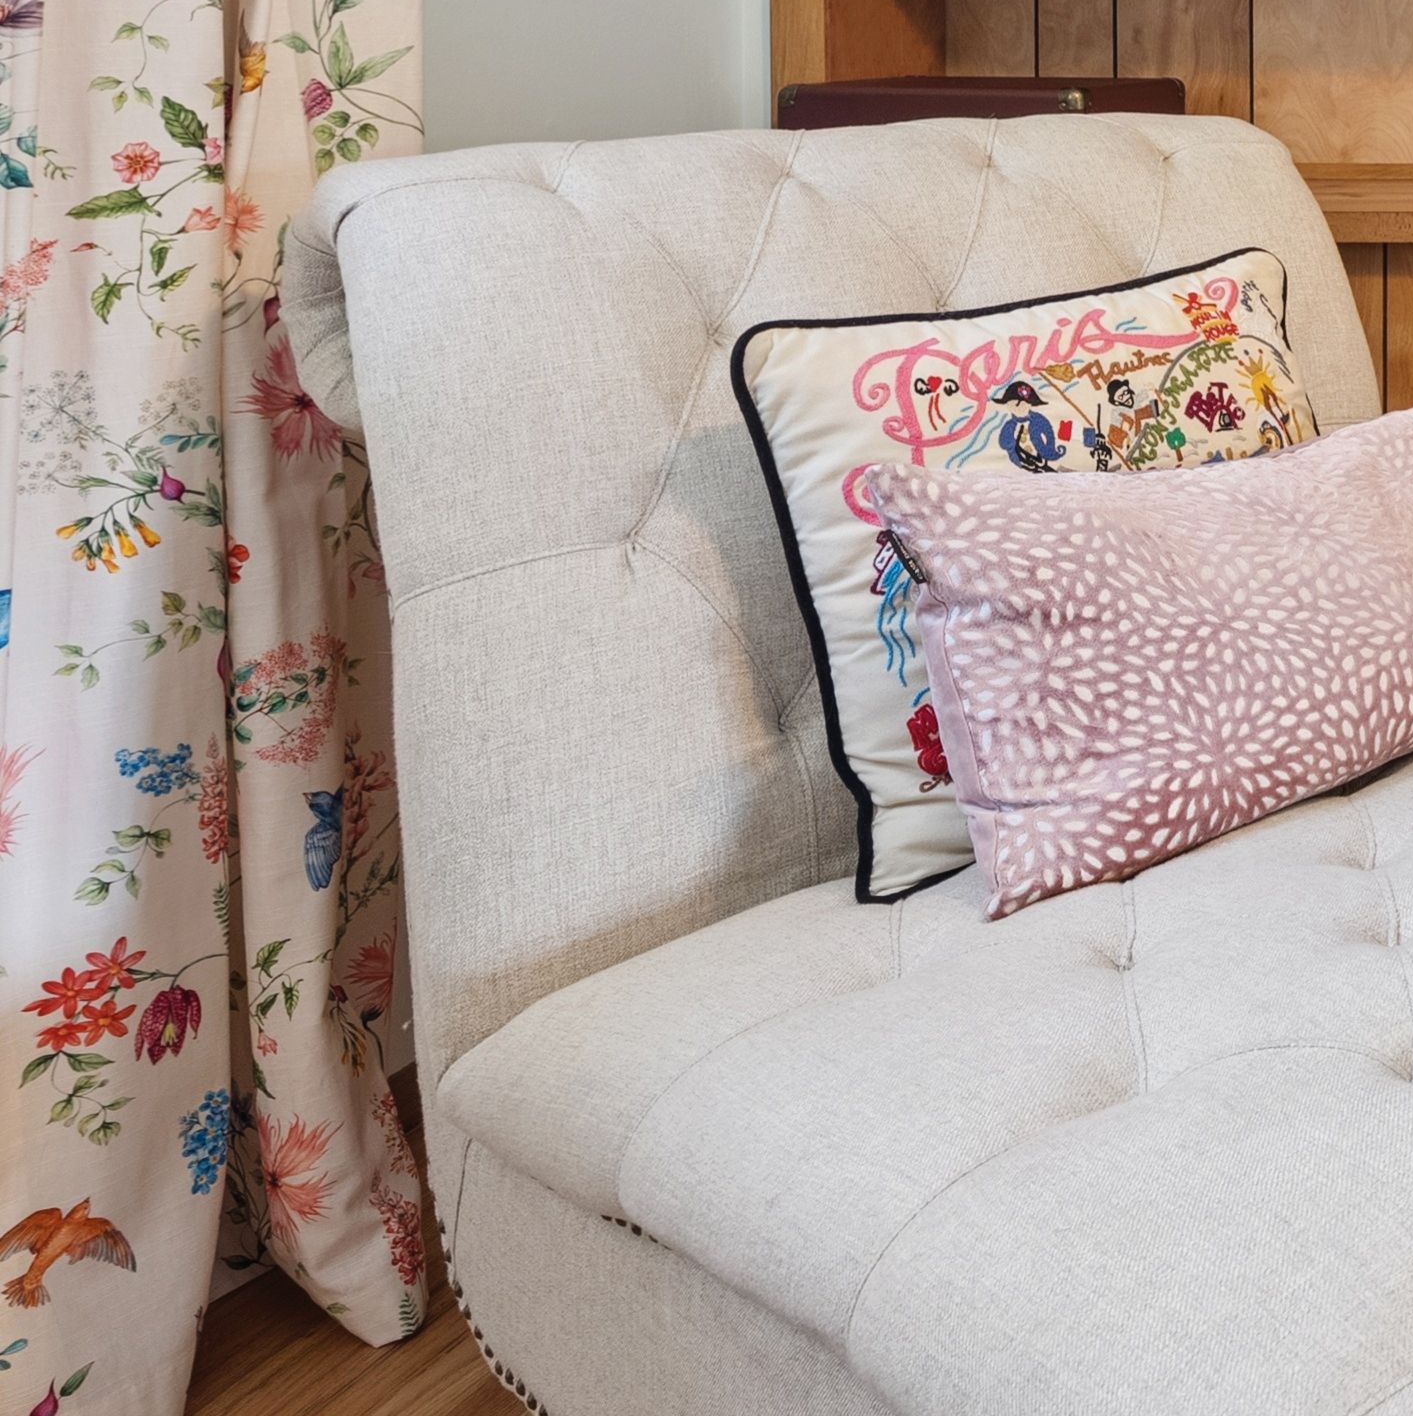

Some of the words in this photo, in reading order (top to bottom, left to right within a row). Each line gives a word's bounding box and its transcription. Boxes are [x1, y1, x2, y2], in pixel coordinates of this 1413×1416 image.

[1190, 310, 1232, 331] MOULIN
[1204, 324, 1240, 344] ROUGE
[853, 306, 1205, 468] Paris
